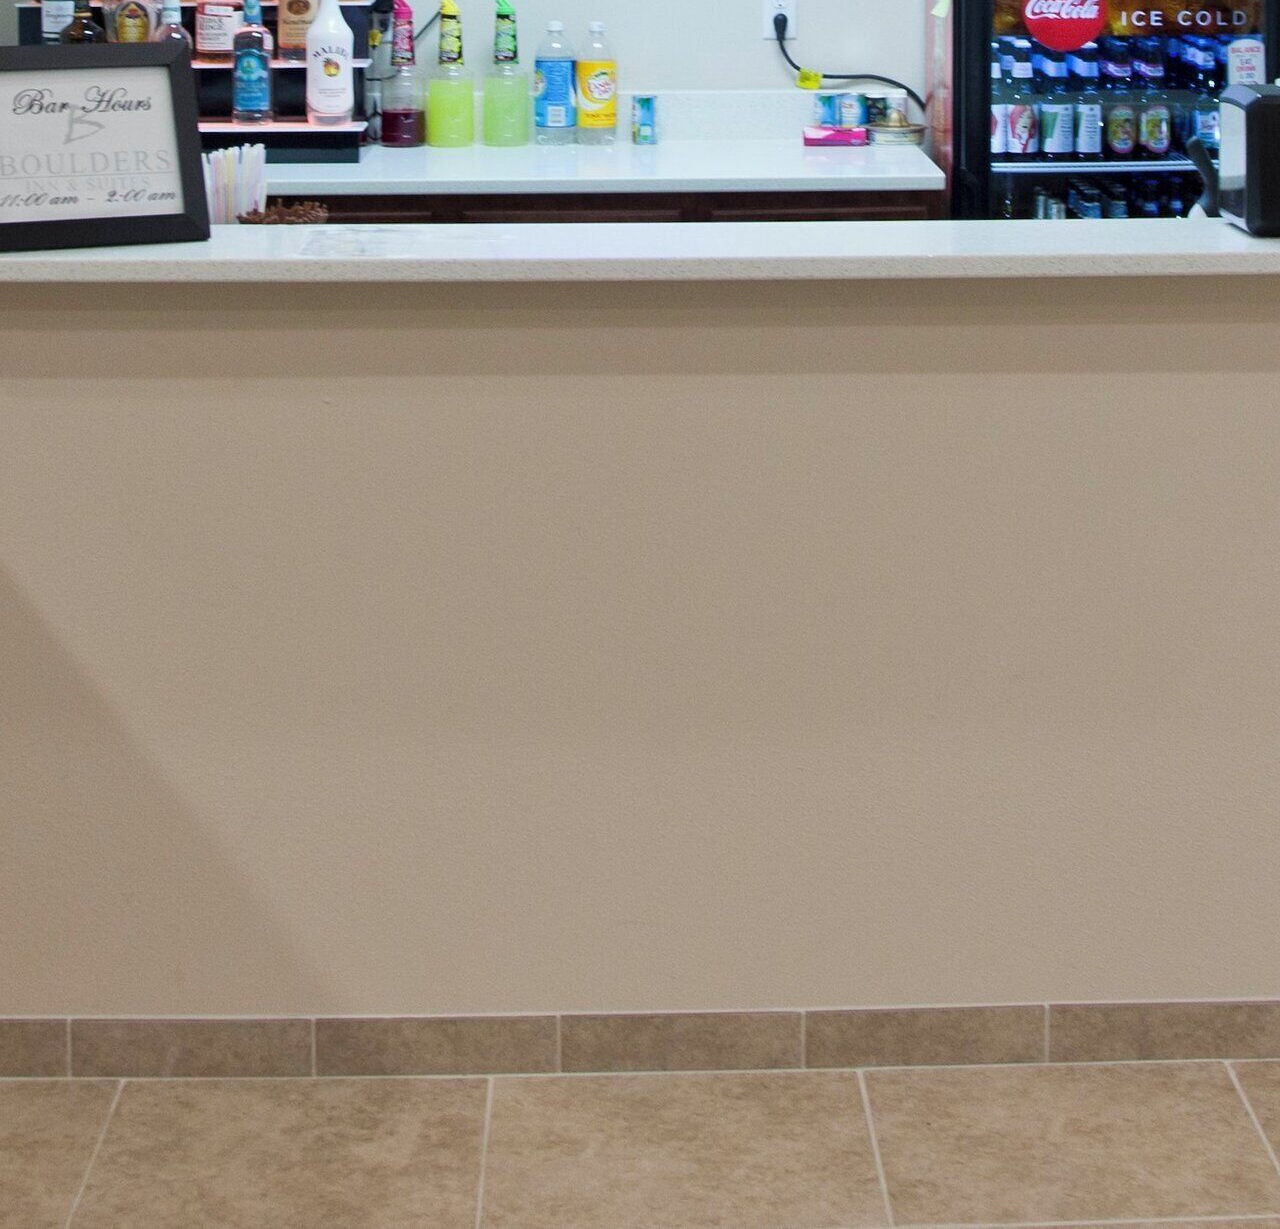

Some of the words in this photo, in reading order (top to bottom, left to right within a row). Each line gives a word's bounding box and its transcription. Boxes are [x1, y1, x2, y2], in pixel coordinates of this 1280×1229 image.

[1120, 10, 1164, 27] ICE
[1177, 10, 1249, 27] COLD
[12, 88, 68, 115] Bar
[81, 85, 152, 113] Hours
[0, 192, 48, 207] 11:00
[49, 197, 79, 205] am
[106, 188, 147, 202] 2:00
[147, 191, 177, 201] am
